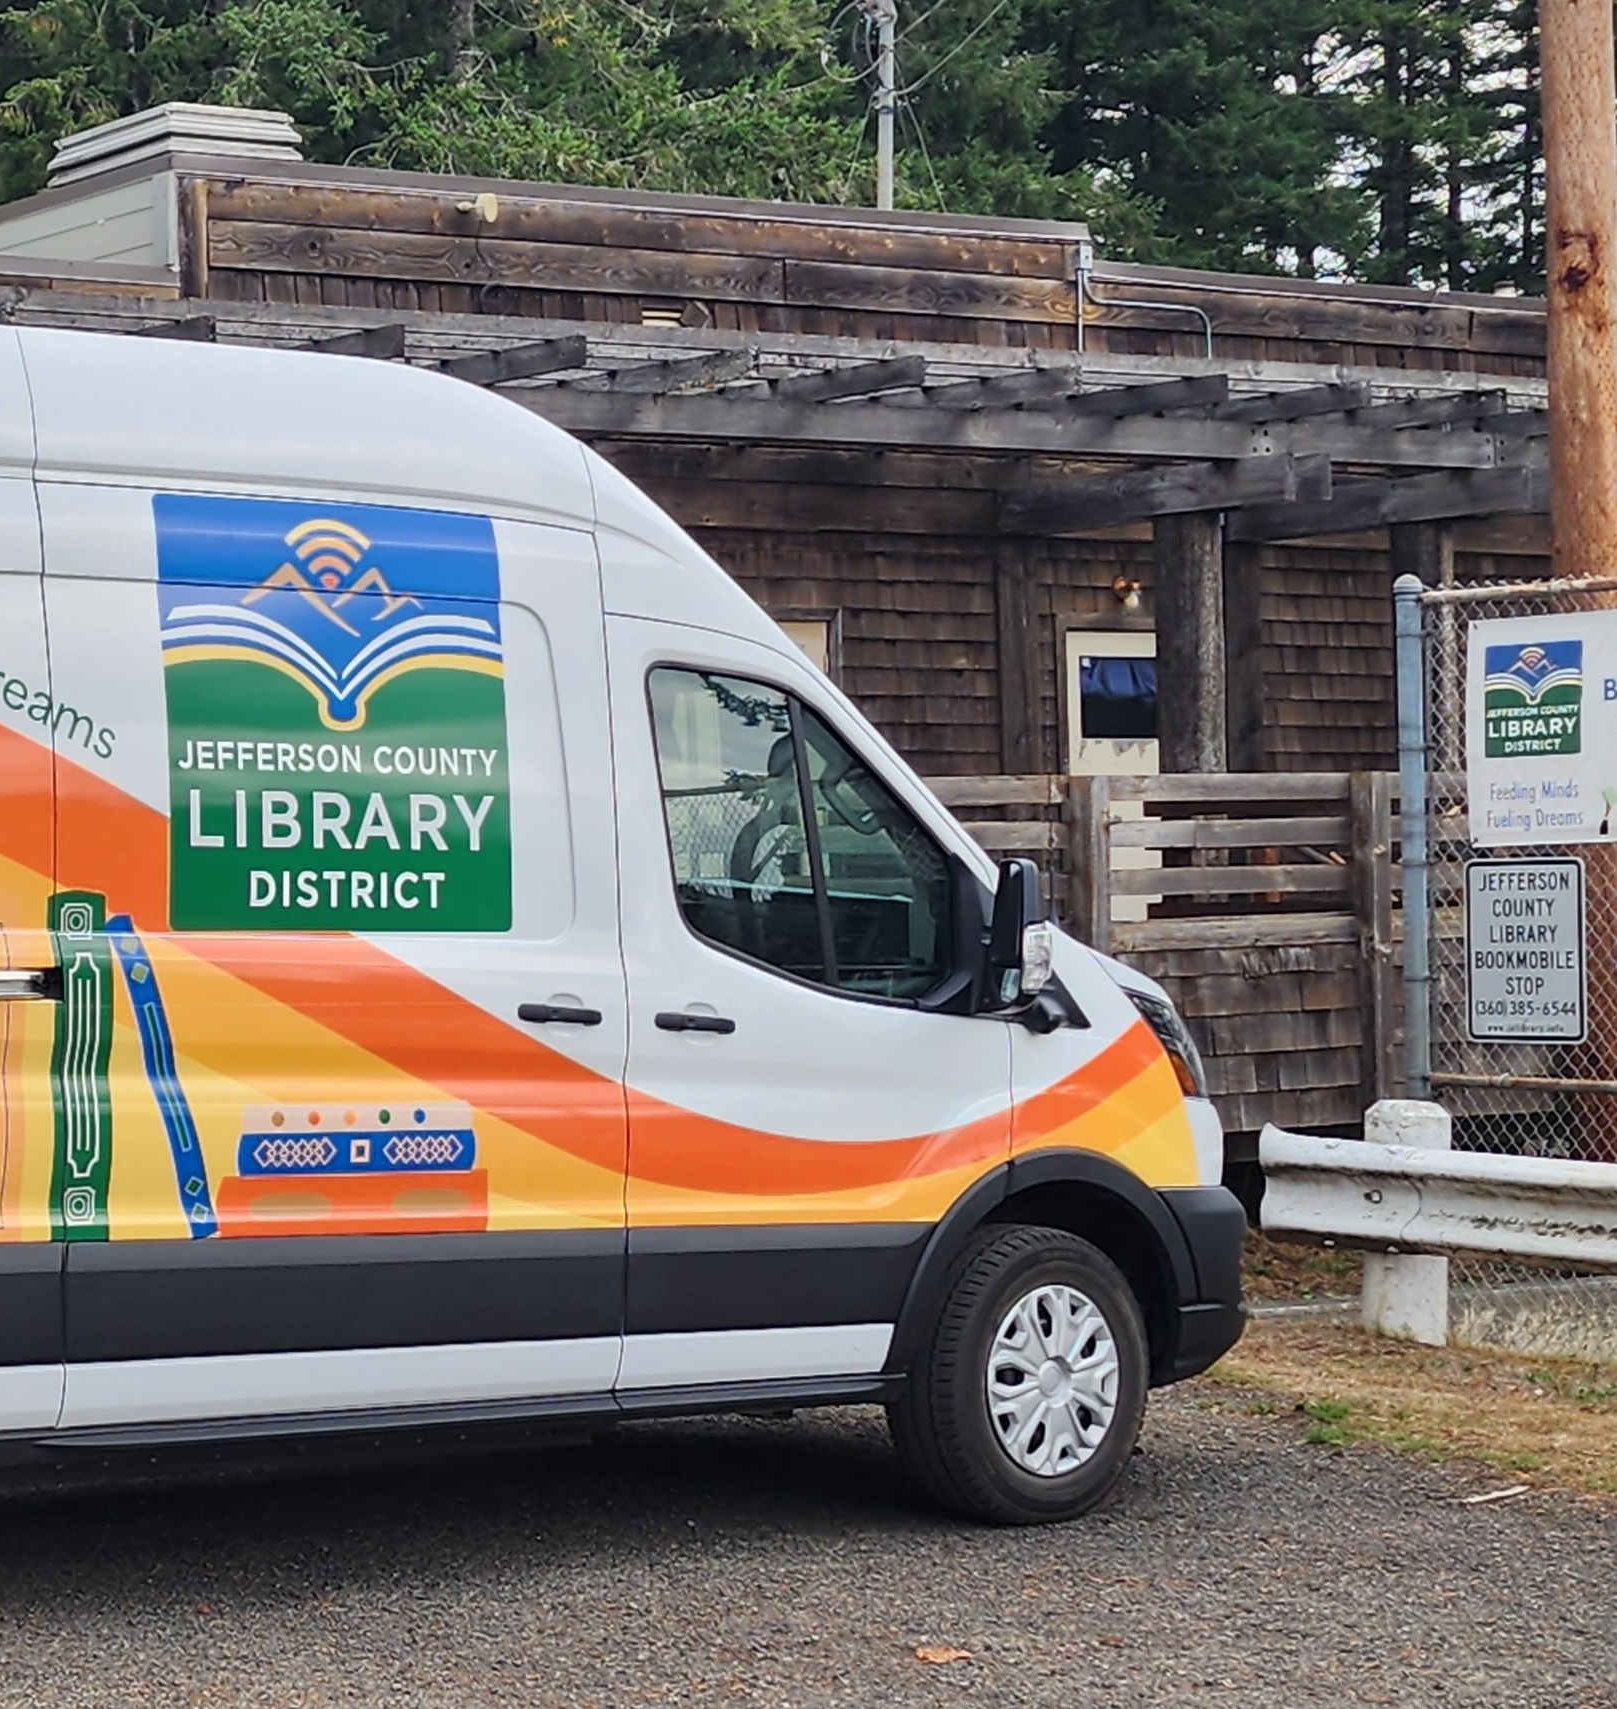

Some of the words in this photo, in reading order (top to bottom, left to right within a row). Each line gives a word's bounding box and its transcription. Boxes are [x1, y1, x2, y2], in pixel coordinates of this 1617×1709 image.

[1486, 706, 1538, 719] JEFFERSON
[1540, 704, 1580, 716] COUNTY
[1488, 717, 1577, 738] LIBRARY
[1504, 738, 1562, 753] DISTRICT
[178, 740, 362, 773] JEFFERSON
[373, 745, 498, 776] COUNTY
[1490, 780, 1536, 804] Feeding
[1541, 778, 1579, 799] Minds
[188, 788, 495, 852] LIBRARY
[1486, 809, 1531, 832] Fueling
[1536, 807, 1583, 827] Dreams
[248, 869, 447, 909] DISTRICT
[1478, 872, 1570, 892] JEFFERSON
[1492, 898, 1555, 917] COUNTY
[1489, 925, 1558, 944] LIBRARY
[1475, 951, 1575, 970] BOOKMOBILE
[1505, 976, 1545, 995] STOP
